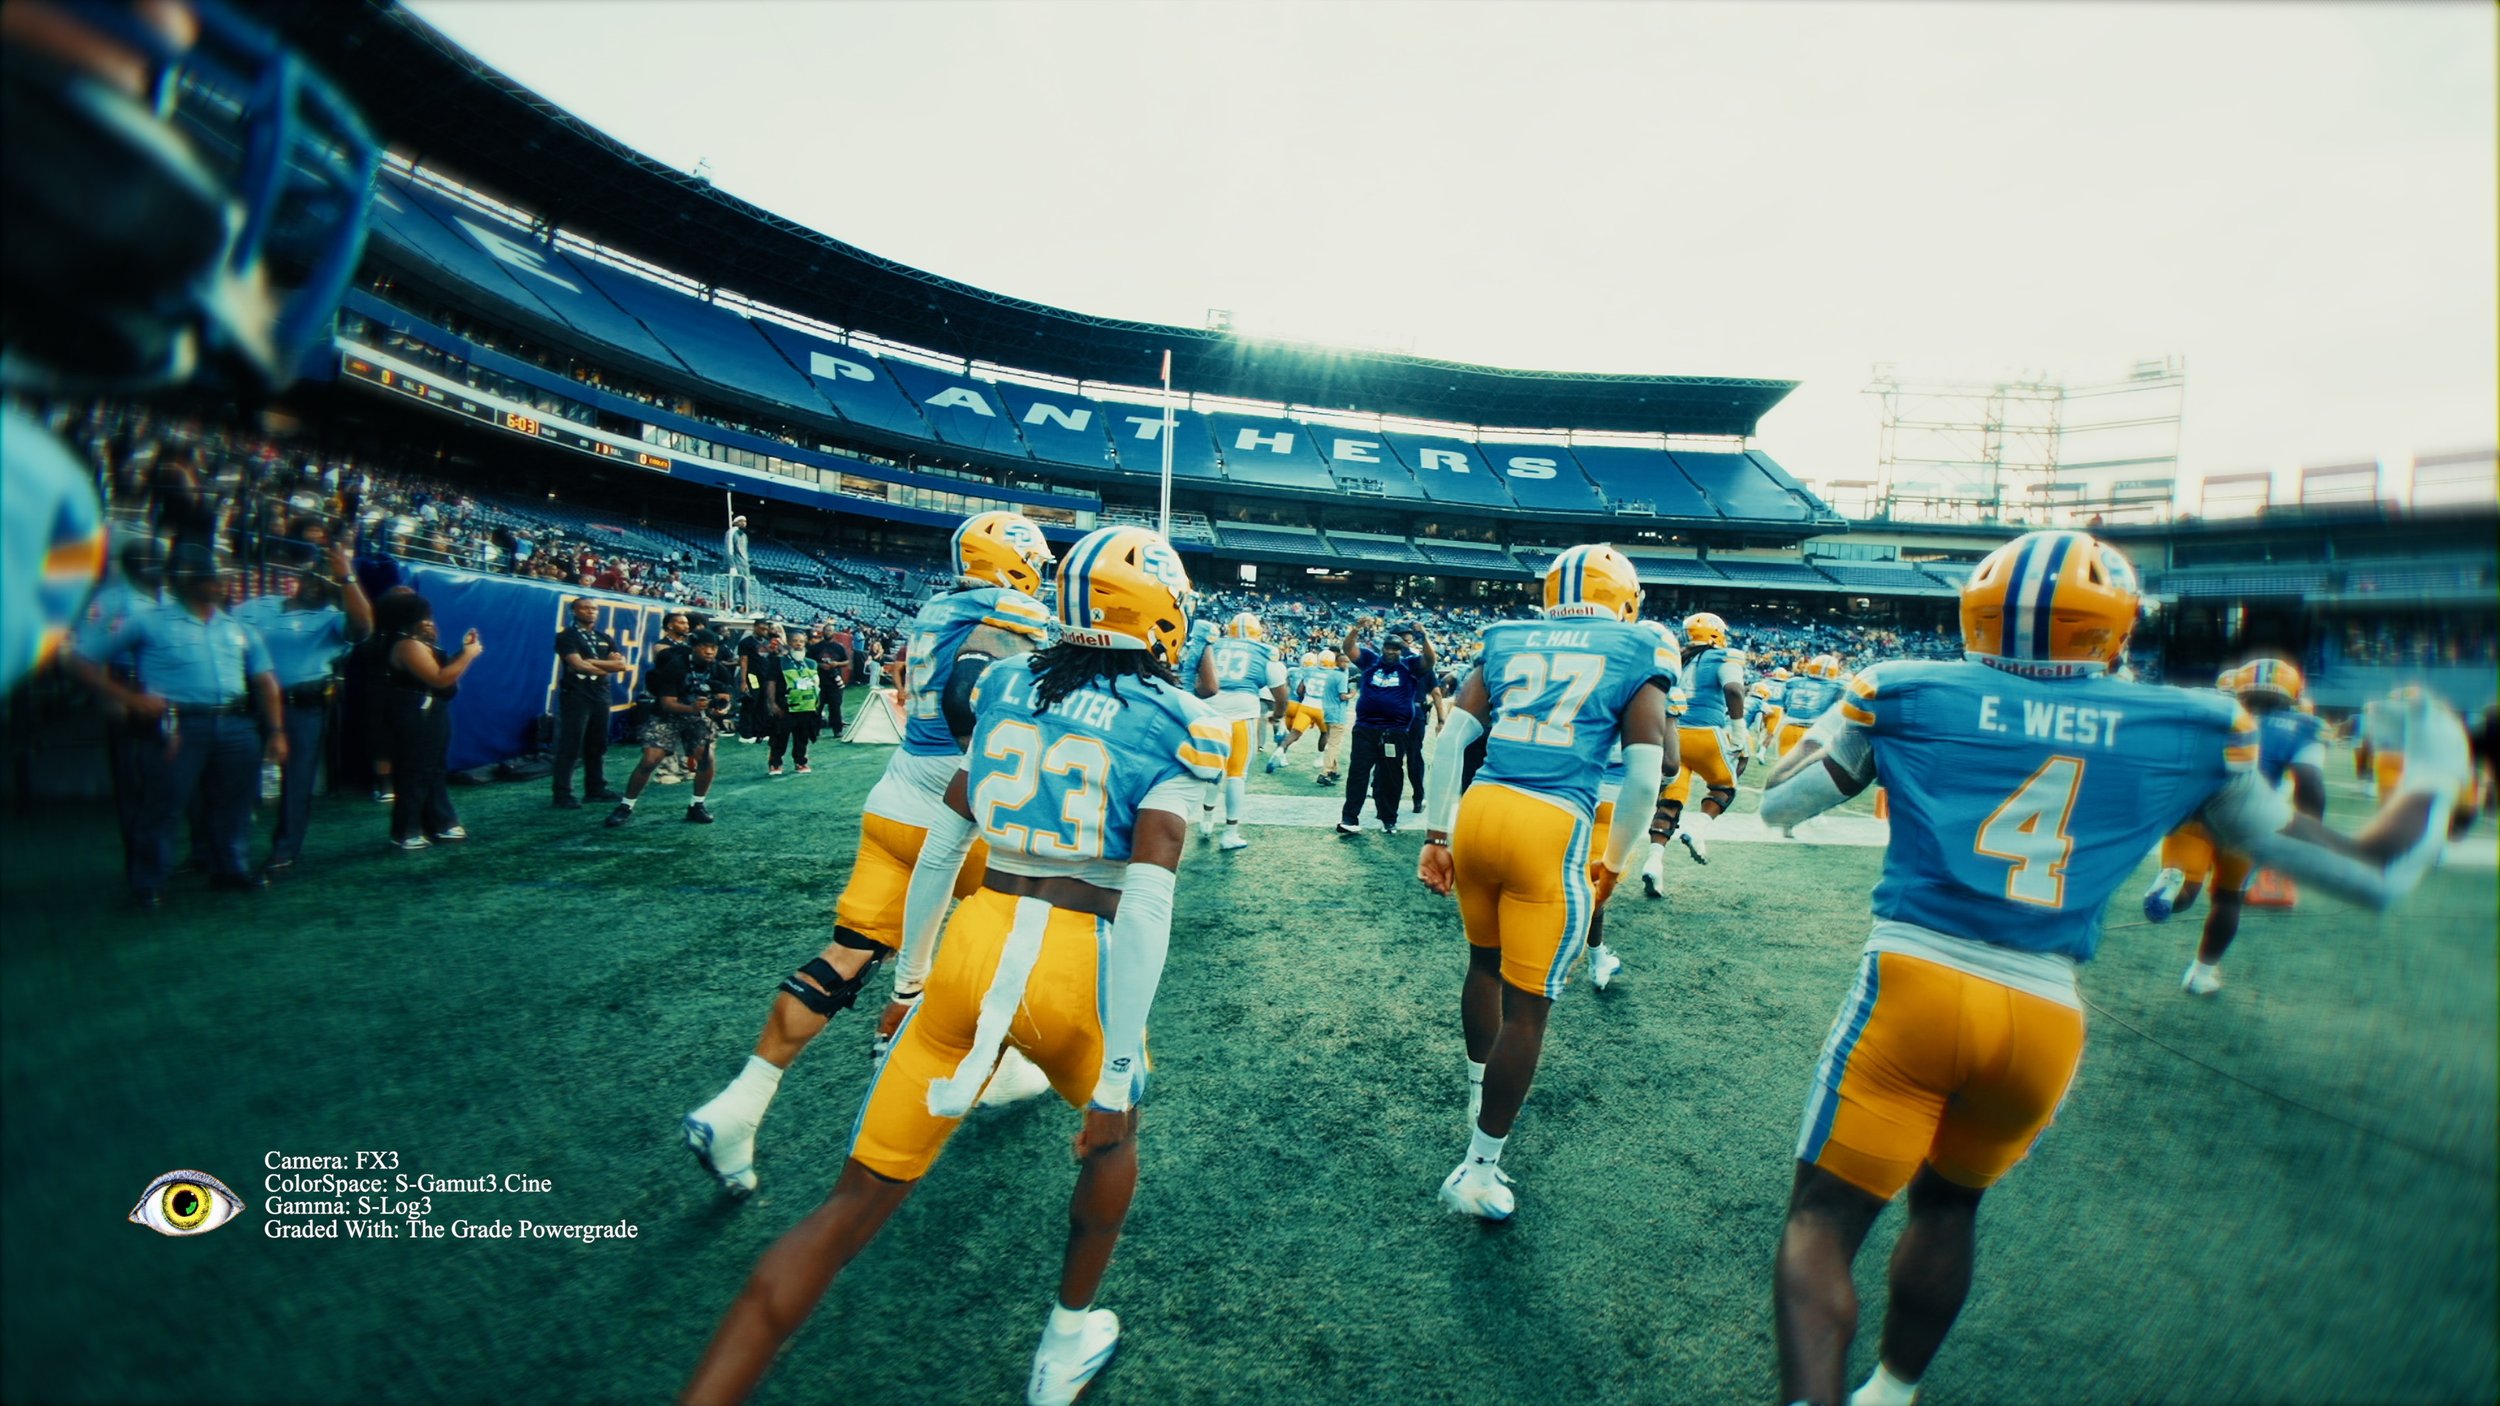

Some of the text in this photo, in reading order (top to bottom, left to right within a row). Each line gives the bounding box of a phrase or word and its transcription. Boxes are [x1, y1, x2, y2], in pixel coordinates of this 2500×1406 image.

[506, 412, 535, 434] 6:03
[810, 350, 1558, 480] PANTHERS
[1550, 606, 1594, 618] Riddell
[1526, 631, 1591, 647] C. HALL
[1982, 657, 2072, 677] Riddell
[1490, 654, 1606, 746] 27
[1978, 696, 2123, 747] E. WEST
[973, 719, 1111, 859] 23
[1973, 754, 2085, 909] 4
